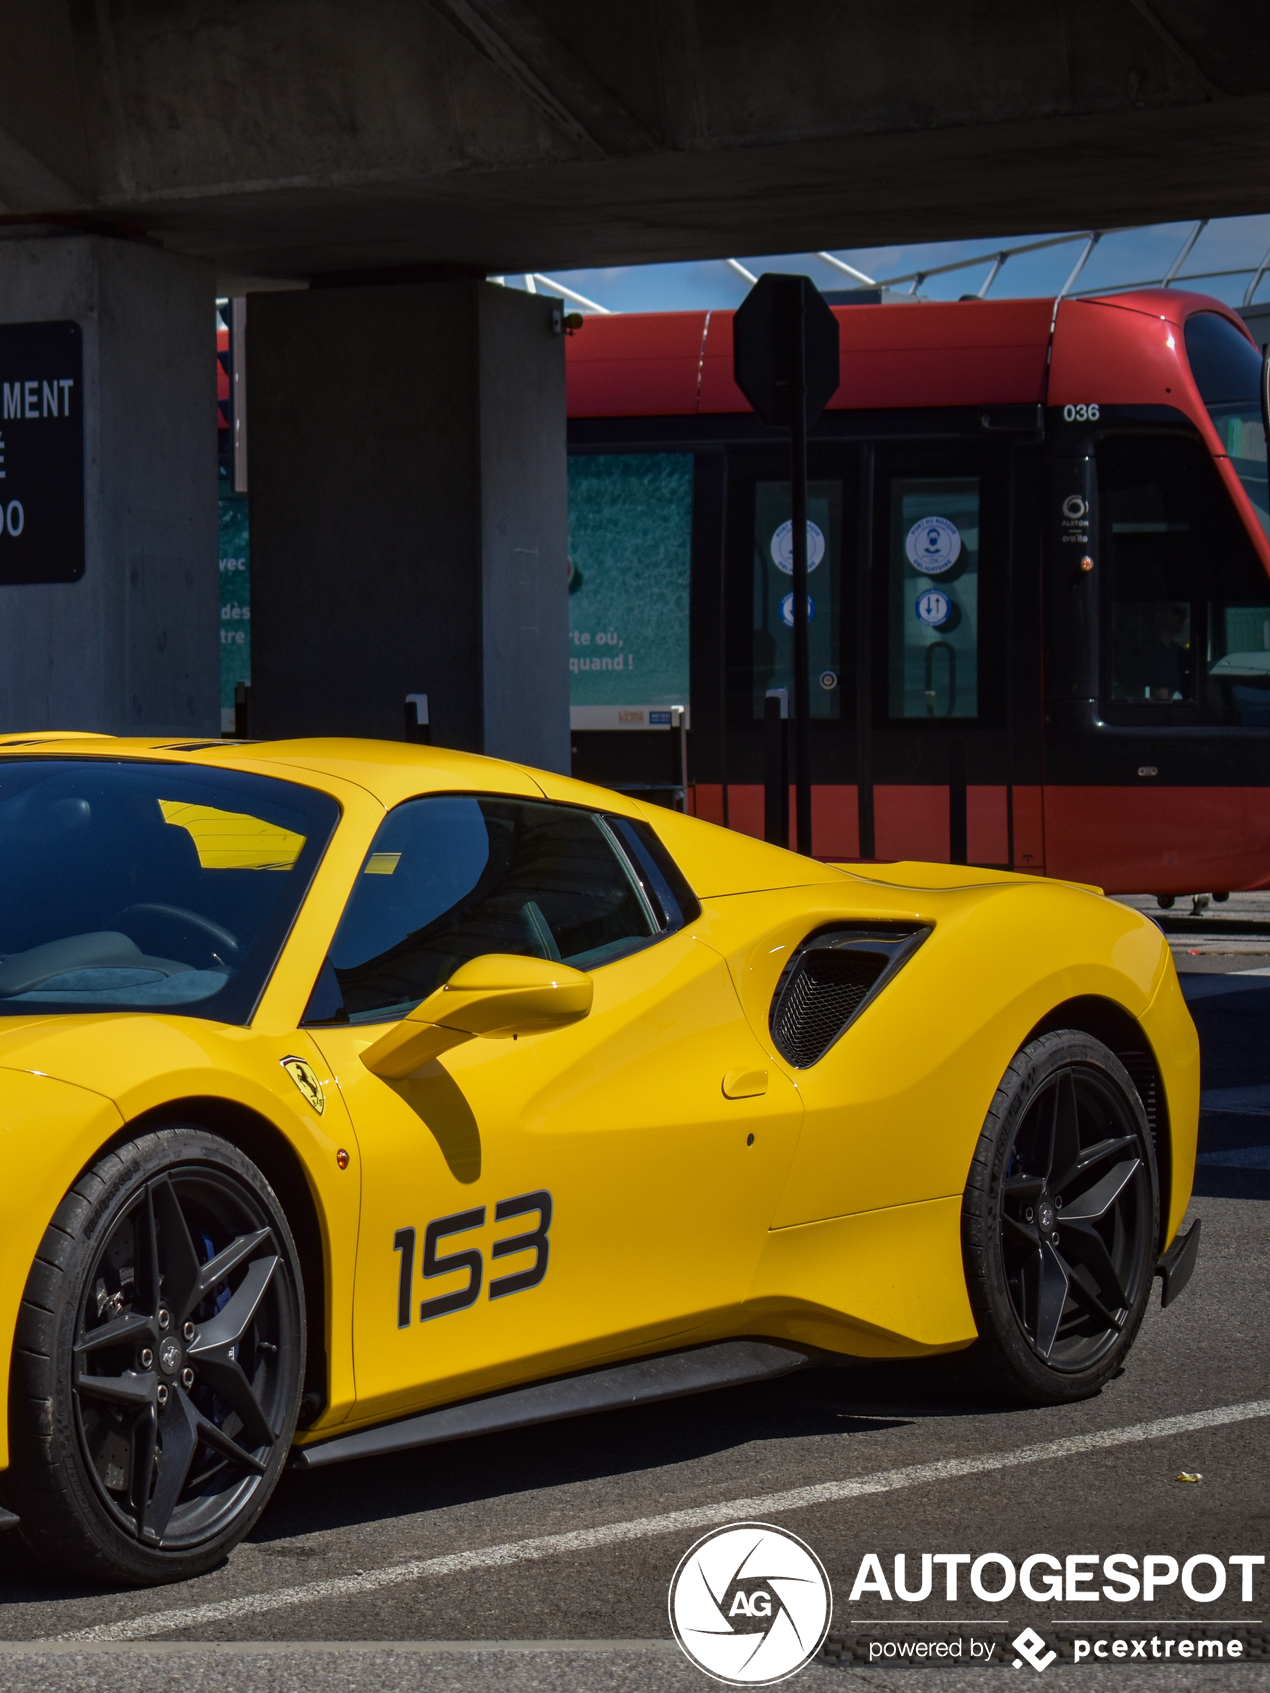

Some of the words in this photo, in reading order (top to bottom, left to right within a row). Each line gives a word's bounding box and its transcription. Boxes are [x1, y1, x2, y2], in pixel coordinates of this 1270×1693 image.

[1063, 403, 1100, 421] 036
[221, 601, 250, 619] dès
[596, 627, 624, 648] où,
[569, 653, 624, 674] quand
[393, 1188, 554, 1330] 153
